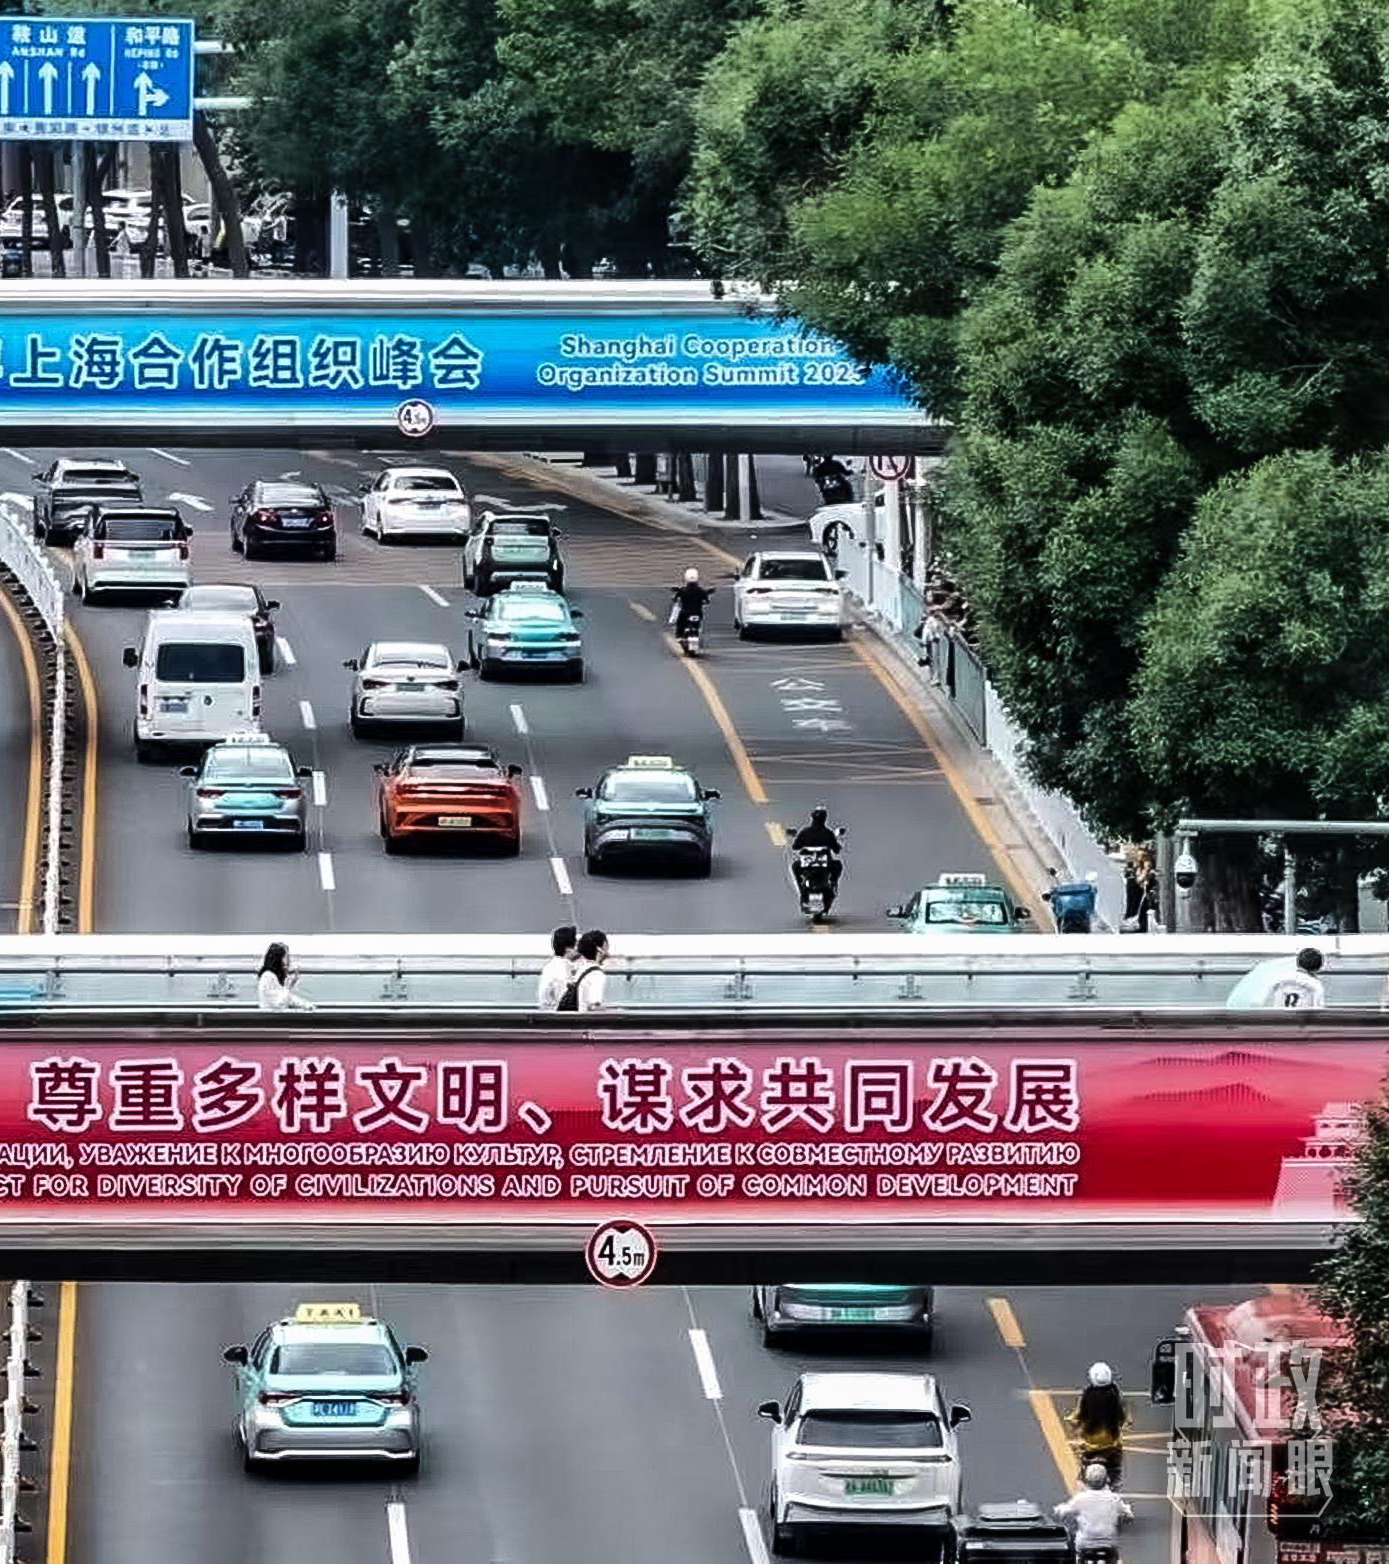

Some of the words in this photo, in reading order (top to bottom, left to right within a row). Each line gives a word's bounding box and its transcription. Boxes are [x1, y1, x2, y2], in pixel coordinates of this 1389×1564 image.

[125, 26, 180, 45] 和平路
[561, 333, 675, 361] Shanghai
[683, 333, 838, 361] Cooperation
[537, 363, 698, 391] Organization
[703, 363, 797, 385] Summit
[79, 1142, 217, 1165] УВАЖЕНИЕ
[221, 1142, 241, 1165] К
[244, 1142, 450, 1165] МНОГООБРАЗИЮ
[454, 1142, 565, 1169] КУЛЬТУР,
[569, 1142, 732, 1165] СТРЕМЛЕНИЕ
[735, 1142, 755, 1165] К
[756, 1142, 944, 1165] СОВМЕСТНОМУ
[946, 1142, 1081, 1165] РАЗВИТИЮ
[33, 1174, 88, 1197] FOR
[97, 1174, 242, 1197] DIVERSITY
[250, 1174, 288, 1197] OF
[295, 1174, 495, 1197] CIVILIZATIONS
[501, 1174, 562, 1197] AND
[570, 1174, 690, 1197] PURSUIT
[697, 1174, 734, 1197] OF
[742, 1174, 868, 1197] COMMON
[877, 1174, 1079, 1197] DEVELOPMENT
[598, 1235, 645, 1266] 4.5m
